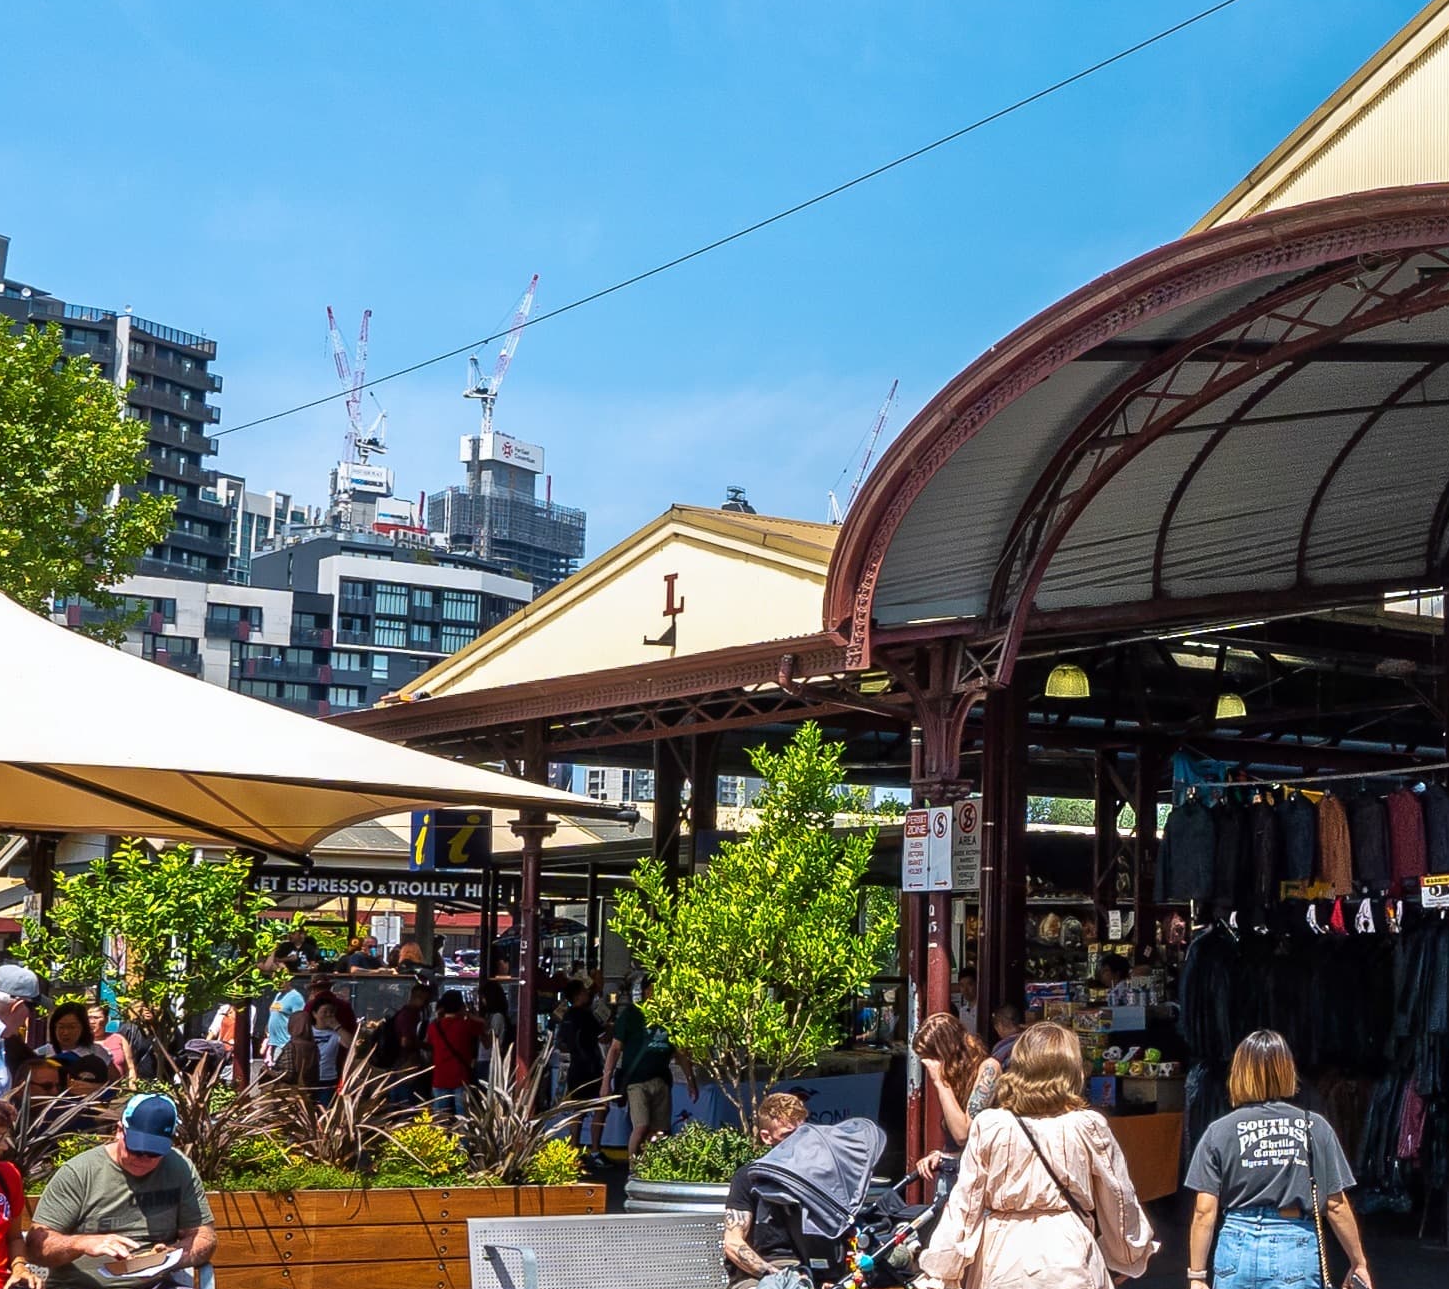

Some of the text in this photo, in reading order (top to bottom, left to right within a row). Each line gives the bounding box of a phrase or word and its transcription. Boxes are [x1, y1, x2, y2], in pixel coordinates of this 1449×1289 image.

[663, 573, 685, 618] L
[287, 877, 373, 894] ESPRESSO
[377, 884, 387, 894] &
[388, 880, 459, 897] TROLLEY
[1237, 1118, 1290, 1136] SOUTH
